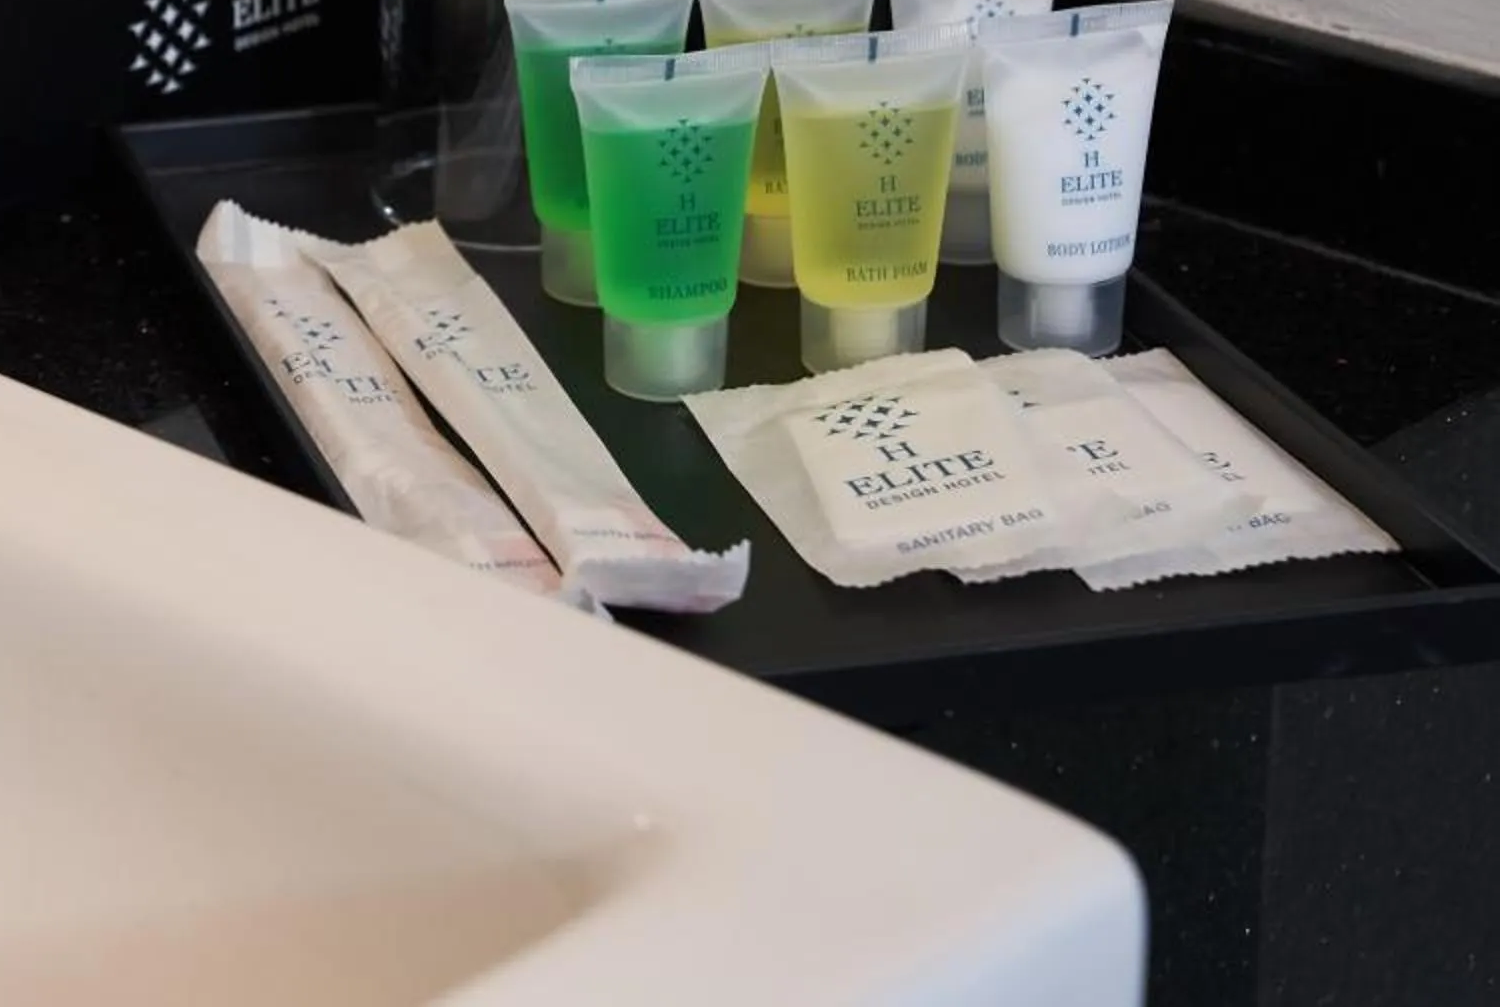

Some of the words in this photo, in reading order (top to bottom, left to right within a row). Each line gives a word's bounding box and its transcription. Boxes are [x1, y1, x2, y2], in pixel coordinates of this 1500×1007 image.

[1084, 151, 1099, 168] H
[880, 175, 896, 193] H
[1061, 170, 1123, 194] ELITE
[680, 192, 695, 211] H
[856, 195, 921, 217] ELITE
[655, 211, 720, 236] ELITE
[1047, 242, 1086, 257] BODY
[846, 265, 887, 282] BATH
[877, 441, 917, 463] H
[845, 449, 995, 498] ELITE
[865, 485, 939, 511] DESIGN
[944, 470, 1006, 492] HOTEL
[897, 519, 995, 554] SANITARY
[999, 507, 1045, 527] BAG
